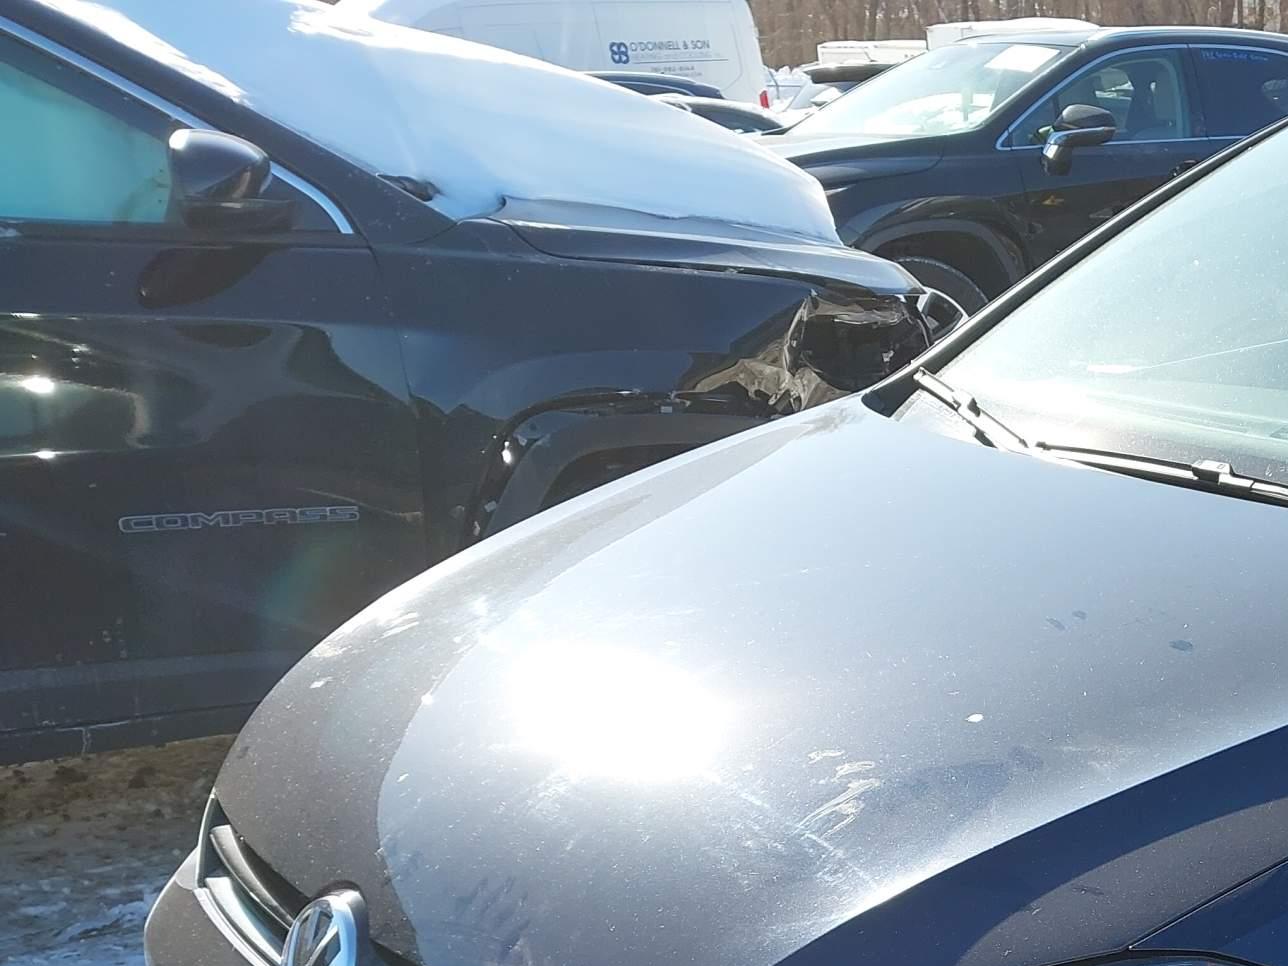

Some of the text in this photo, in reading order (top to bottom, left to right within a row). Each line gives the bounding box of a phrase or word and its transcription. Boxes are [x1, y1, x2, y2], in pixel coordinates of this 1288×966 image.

[630, 40, 710, 51] O'DONNELL & SON
[118, 506, 360, 533] COMPASS
